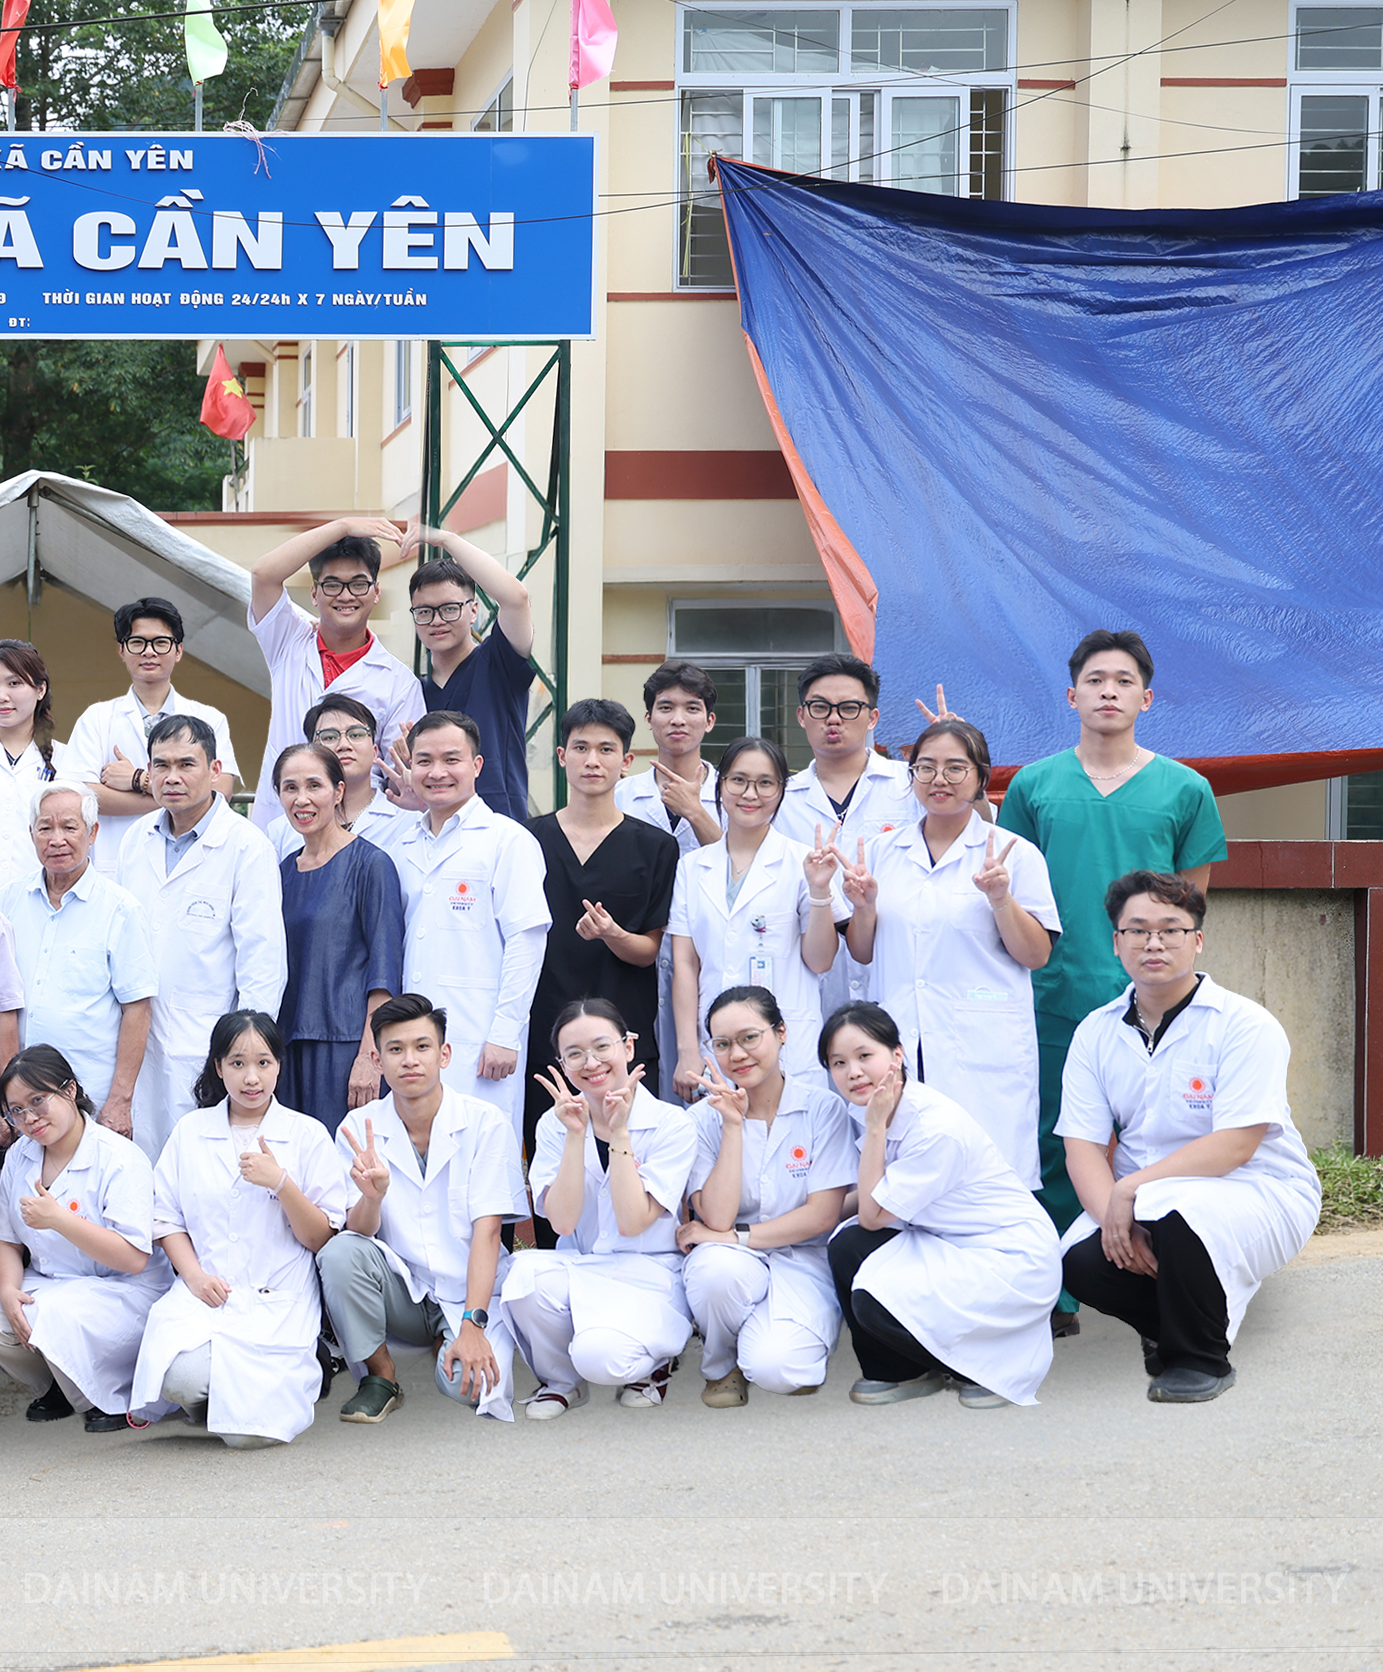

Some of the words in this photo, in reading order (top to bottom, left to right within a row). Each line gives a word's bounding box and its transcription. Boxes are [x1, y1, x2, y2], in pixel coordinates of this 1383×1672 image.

[41, 141, 112, 170] CẦN
[125, 143, 194, 170] YÊN
[72, 188, 284, 271] CẦN
[314, 194, 515, 270] YÊN
[42, 288, 80, 305] THỜI
[85, 292, 125, 305] GIAN
[131, 292, 172, 308] HOẠT
[179, 289, 224, 309] ĐỘNG
[231, 292, 291, 306] 24/24h
[297, 293, 309, 306] X
[315, 293, 326, 306] 7
[332, 287, 427, 308] NGÀY/TUẦN
